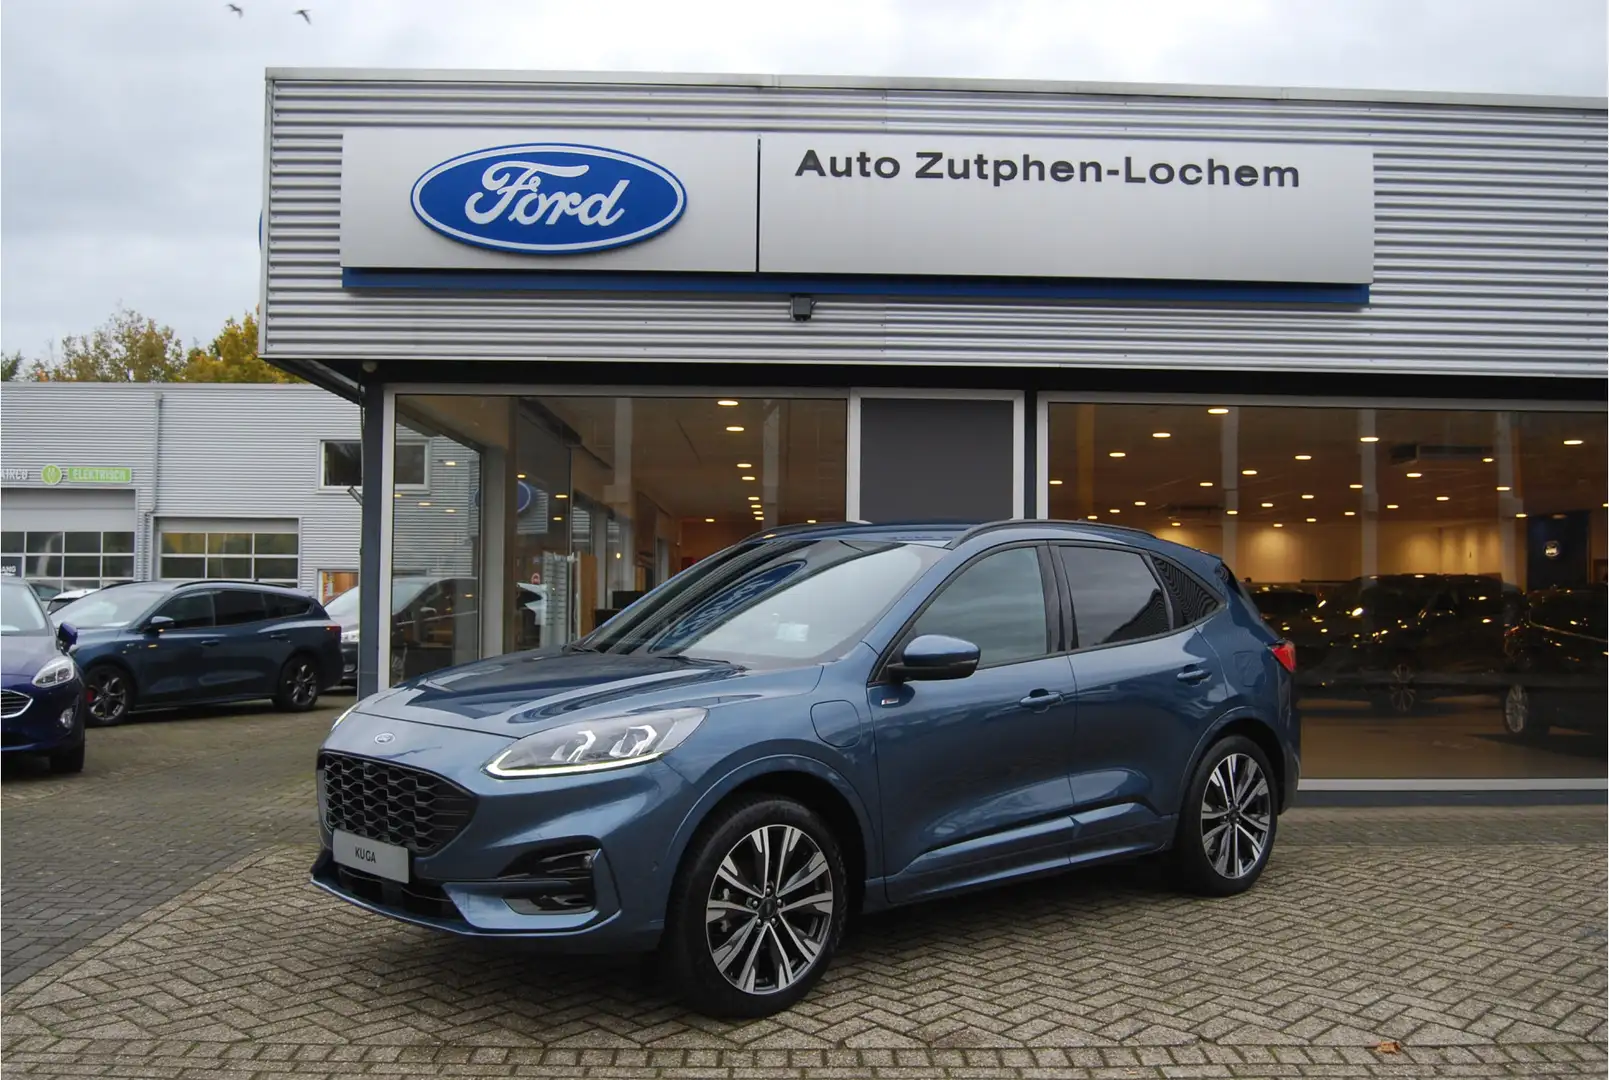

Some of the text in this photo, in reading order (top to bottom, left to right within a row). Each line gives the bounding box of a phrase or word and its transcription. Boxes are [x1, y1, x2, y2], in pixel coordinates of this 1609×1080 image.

[795, 149, 1300, 187] Auto Zutphen-Lochem
[464, 160, 630, 227] Ford
[72, 469, 125, 480] ELEKTRISCH
[354, 846, 377, 864] KUGA
